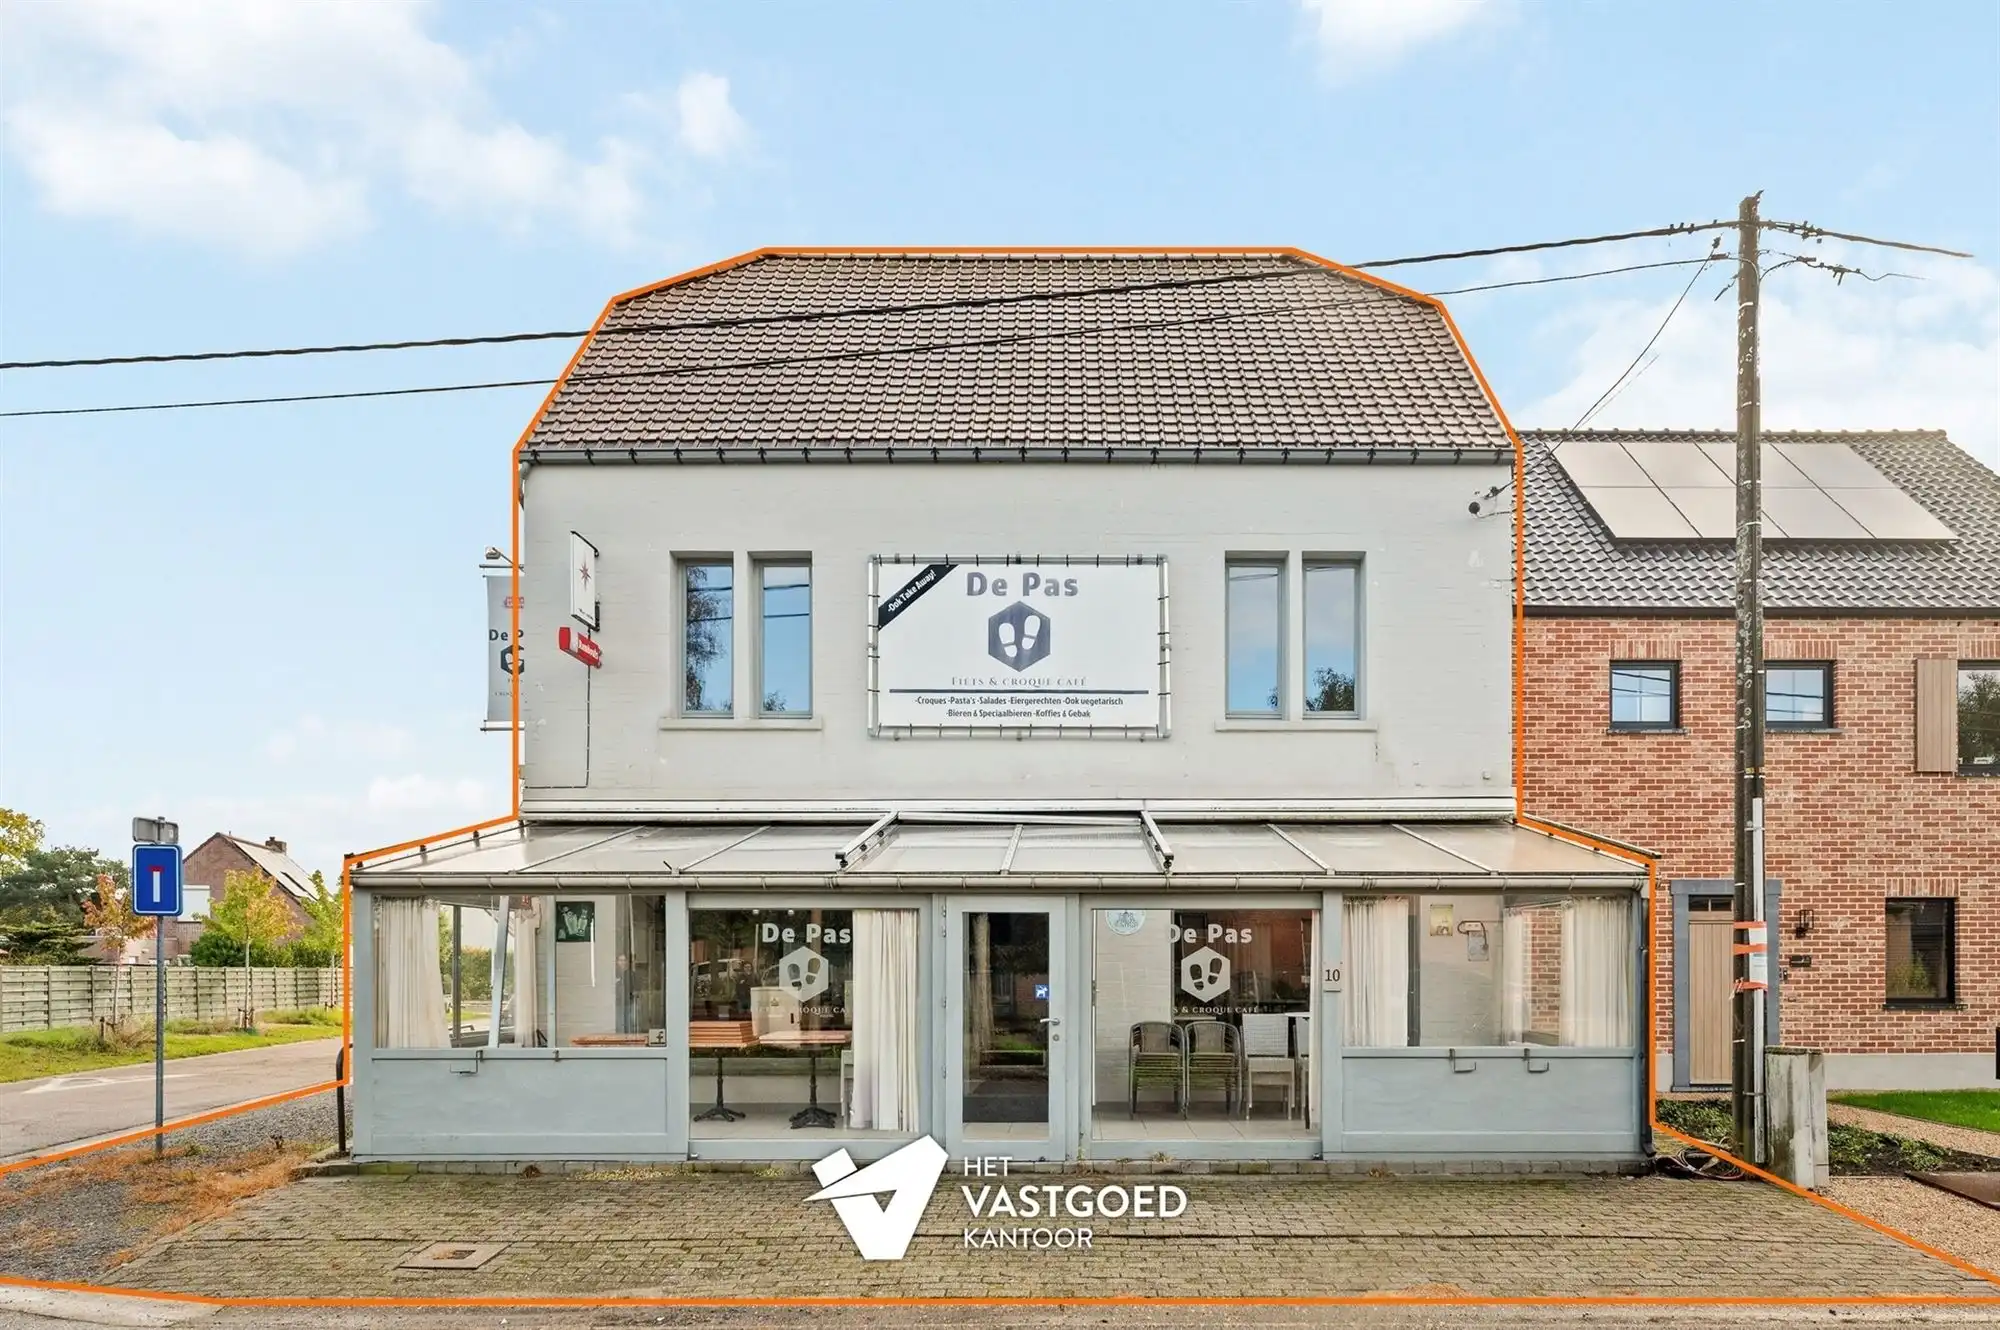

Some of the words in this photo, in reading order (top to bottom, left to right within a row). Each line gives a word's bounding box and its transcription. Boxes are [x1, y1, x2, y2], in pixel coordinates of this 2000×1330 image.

[899, 586, 918, 602] Take
[915, 568, 937, 590] Away!
[966, 571, 1008, 597] De
[1022, 571, 1079, 597] Pas
[488, 628, 509, 641] De
[988, 677, 998, 687] &
[978, 708, 1033, 719] Speciaalbieren
[1067, 709, 1092, 718] Gebak
[761, 922, 796, 943] De
[805, 923, 852, 944] Pas
[1166, 923, 1198, 944] De
[1206, 923, 1253, 944] Pas
[1324, 968, 1341, 982] 10
